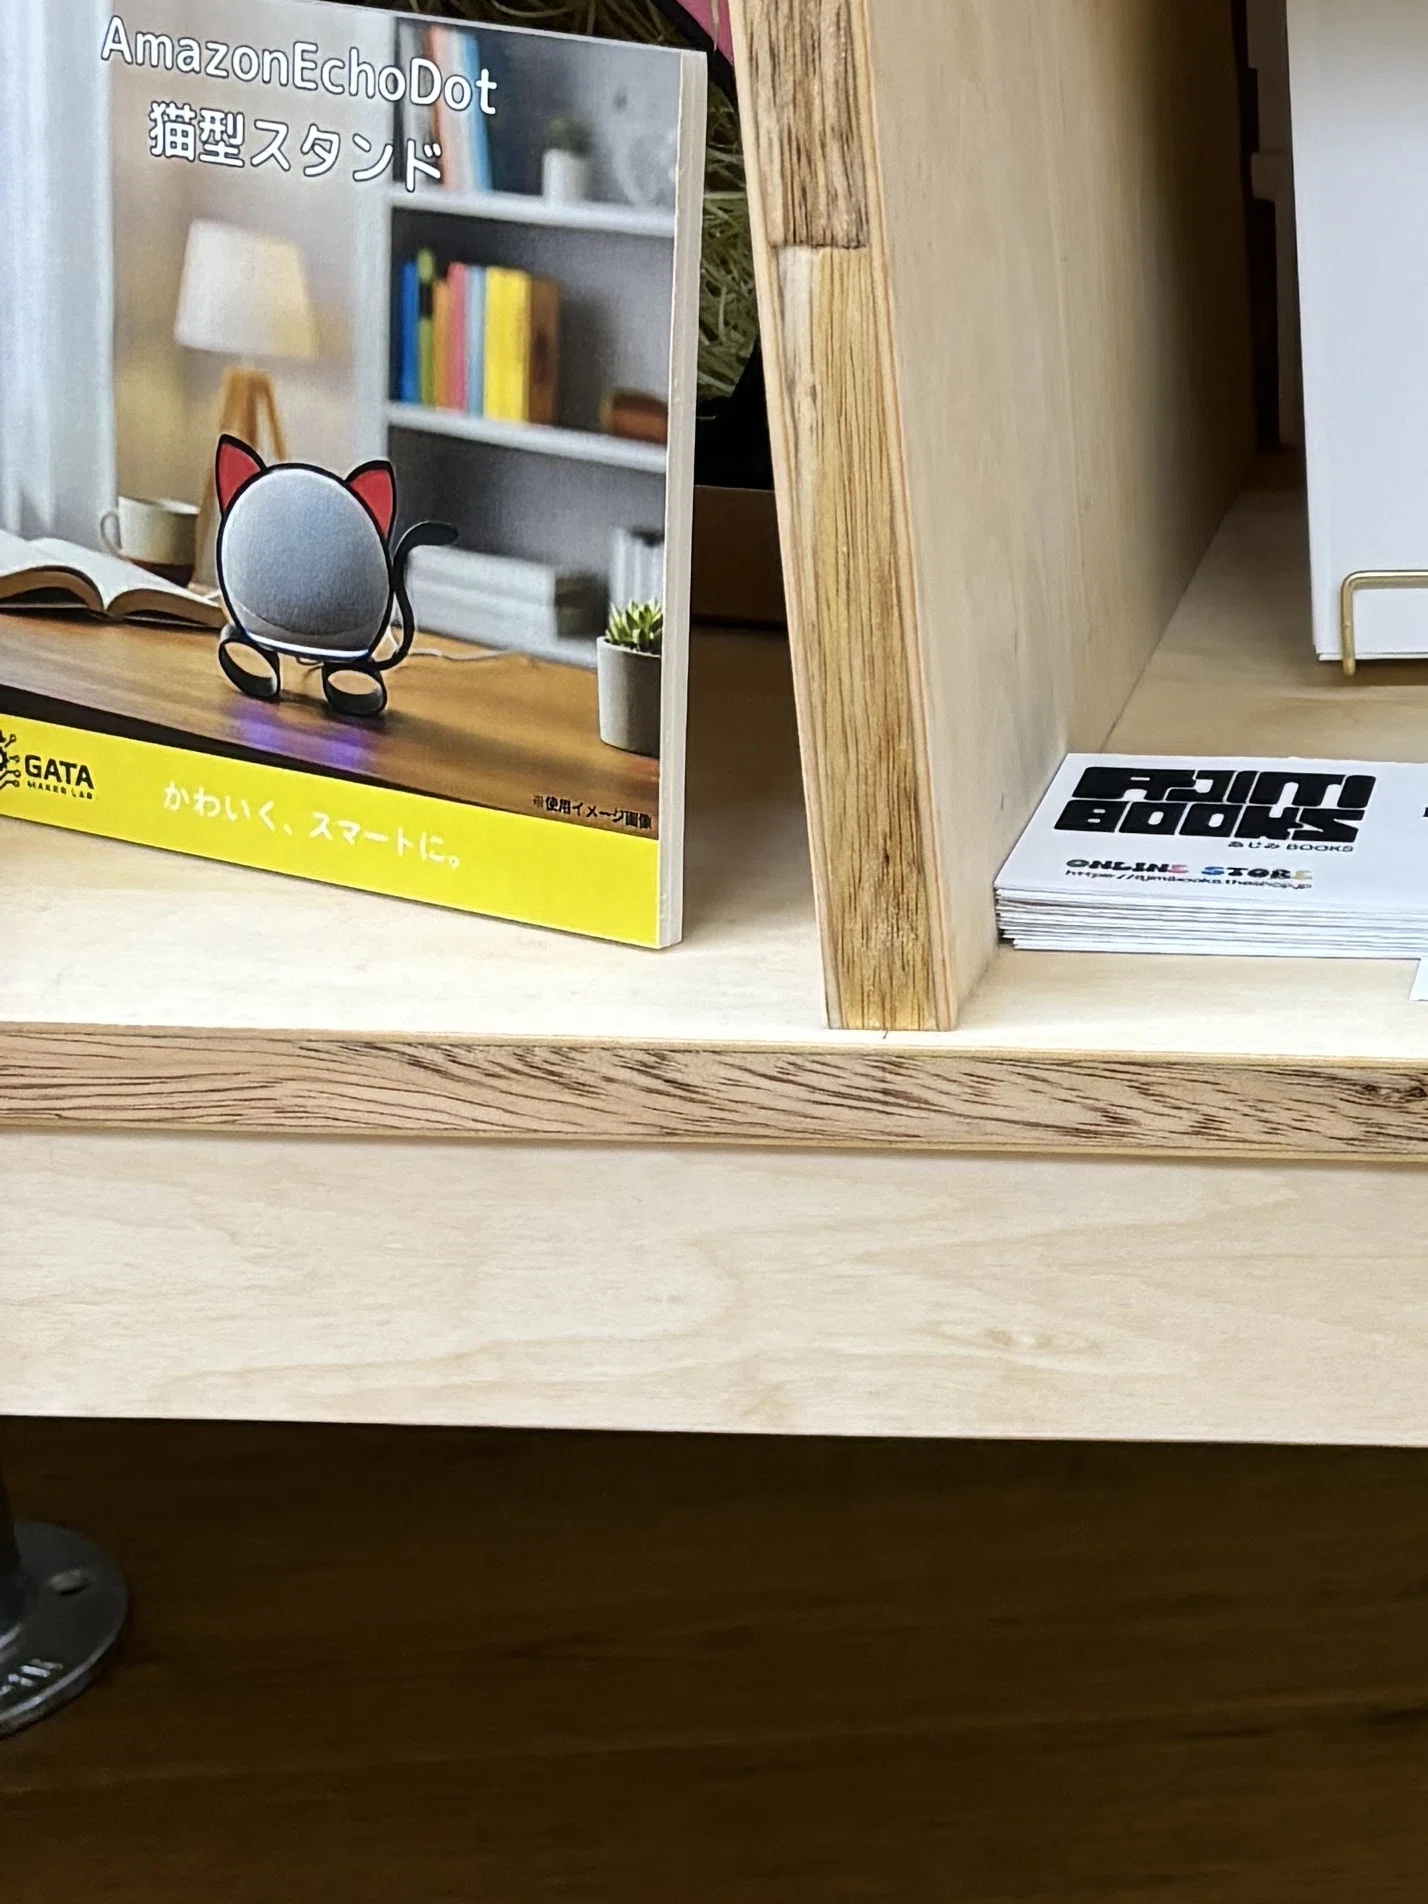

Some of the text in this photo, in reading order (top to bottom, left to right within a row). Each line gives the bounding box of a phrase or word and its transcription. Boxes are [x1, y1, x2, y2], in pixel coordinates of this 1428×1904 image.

[100, 14, 499, 116] AmazonEchoDot
[147, 101, 444, 194] 猫型スタンド
[24, 754, 95, 790] GATA
[162, 779, 463, 871] かわいく、スマートに。
[1053, 799, 1367, 844] BOOKS
[1065, 858, 1313, 881] ONLINE STORE
[1286, 842, 1354, 853] BOOKS
